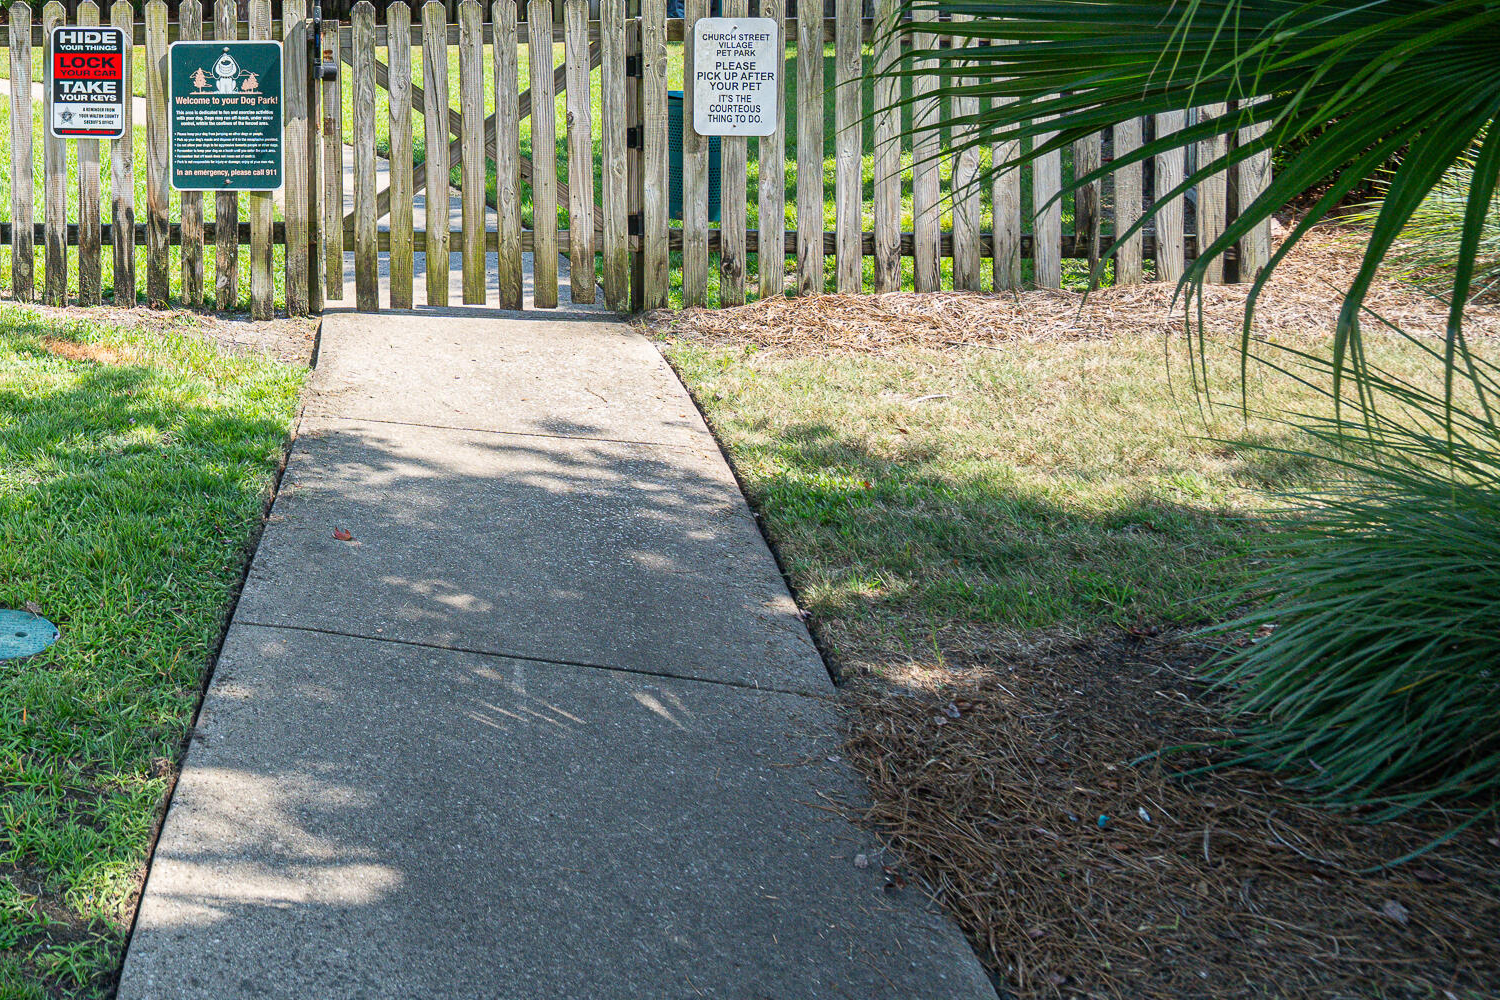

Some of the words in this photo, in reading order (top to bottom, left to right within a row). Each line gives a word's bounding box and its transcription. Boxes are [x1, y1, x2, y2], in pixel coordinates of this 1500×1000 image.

[60, 32, 116, 44] HIDE
[60, 57, 115, 68] LOCK
[716, 62, 756, 70] PLEASE
[697, 72, 721, 80] PICK
[724, 72, 737, 80] UP
[740, 72, 774, 80] AFTER
[60, 81, 116, 93] TAKE
[710, 82, 738, 90] YOUR
[742, 82, 761, 90] PET
[241, 97, 255, 106] Dog
